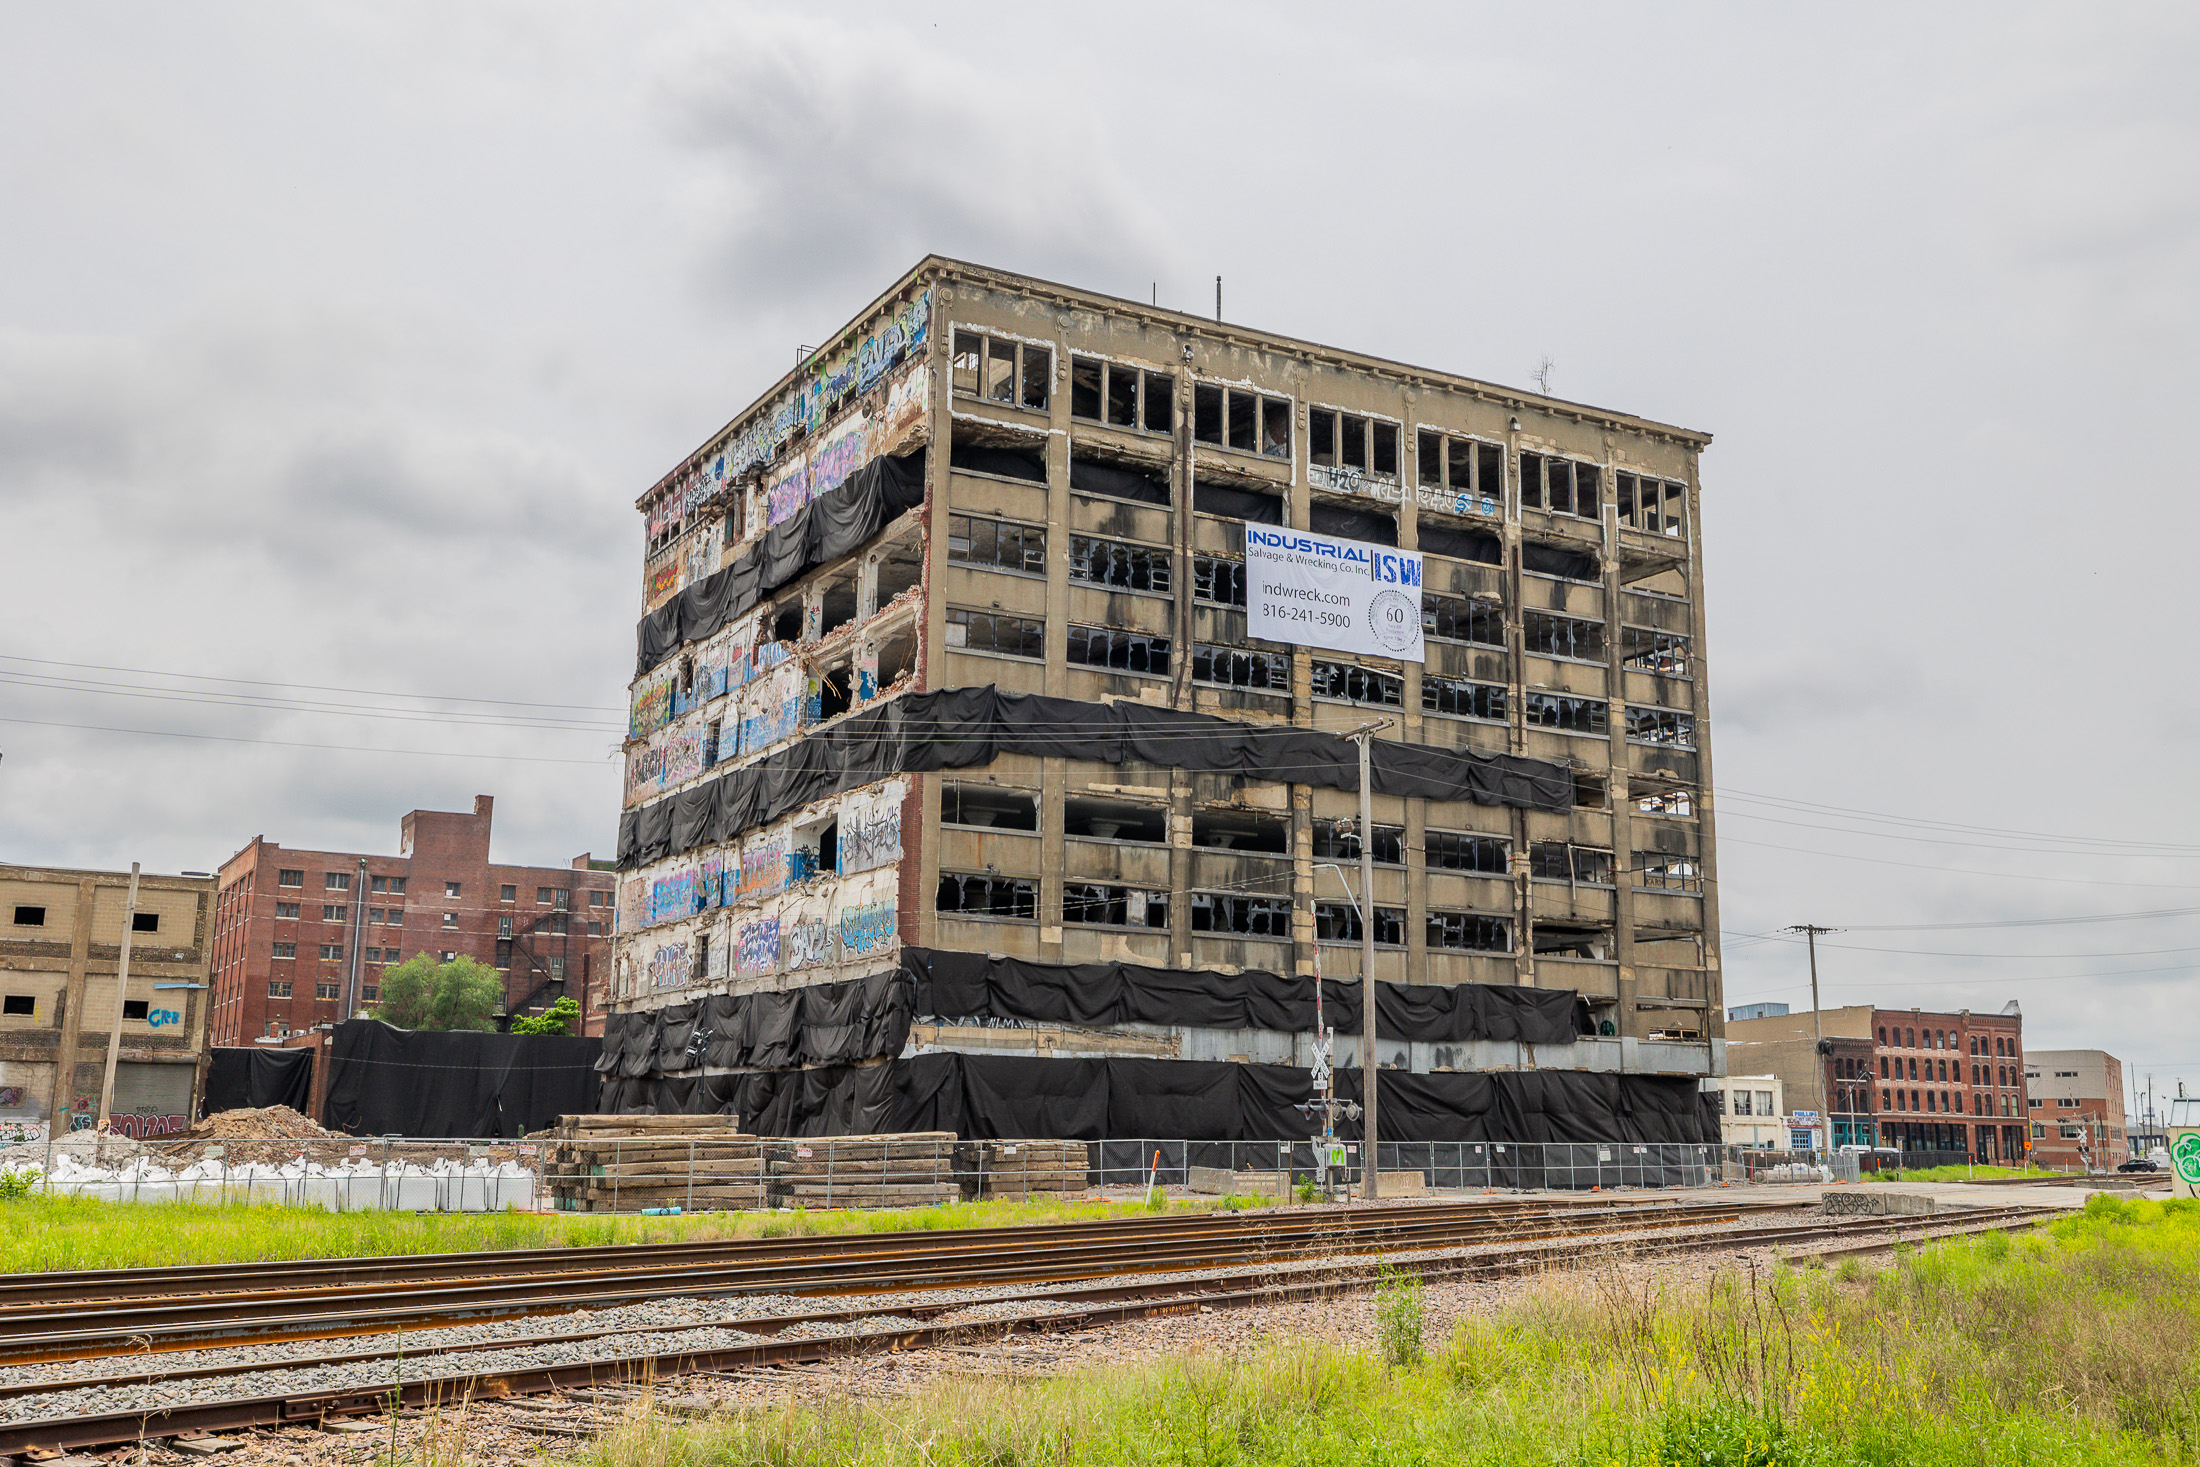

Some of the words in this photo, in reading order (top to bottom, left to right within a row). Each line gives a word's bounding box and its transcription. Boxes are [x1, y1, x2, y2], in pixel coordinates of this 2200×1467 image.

[1248, 530, 1370, 563] INDUSTRIAL
[1248, 547, 1284, 562] Salvage
[1286, 554, 1294, 563] &
[1295, 554, 1338, 573] Wrecking
[1339, 562, 1354, 574] Co.
[1355, 566, 1370, 576] Inc.
[1374, 552, 1421, 587] ISW
[1262, 580, 1350, 607] indwreck.com
[1263, 603, 1351, 628] 816-241-5900
[1386, 607, 1404, 623] 60
